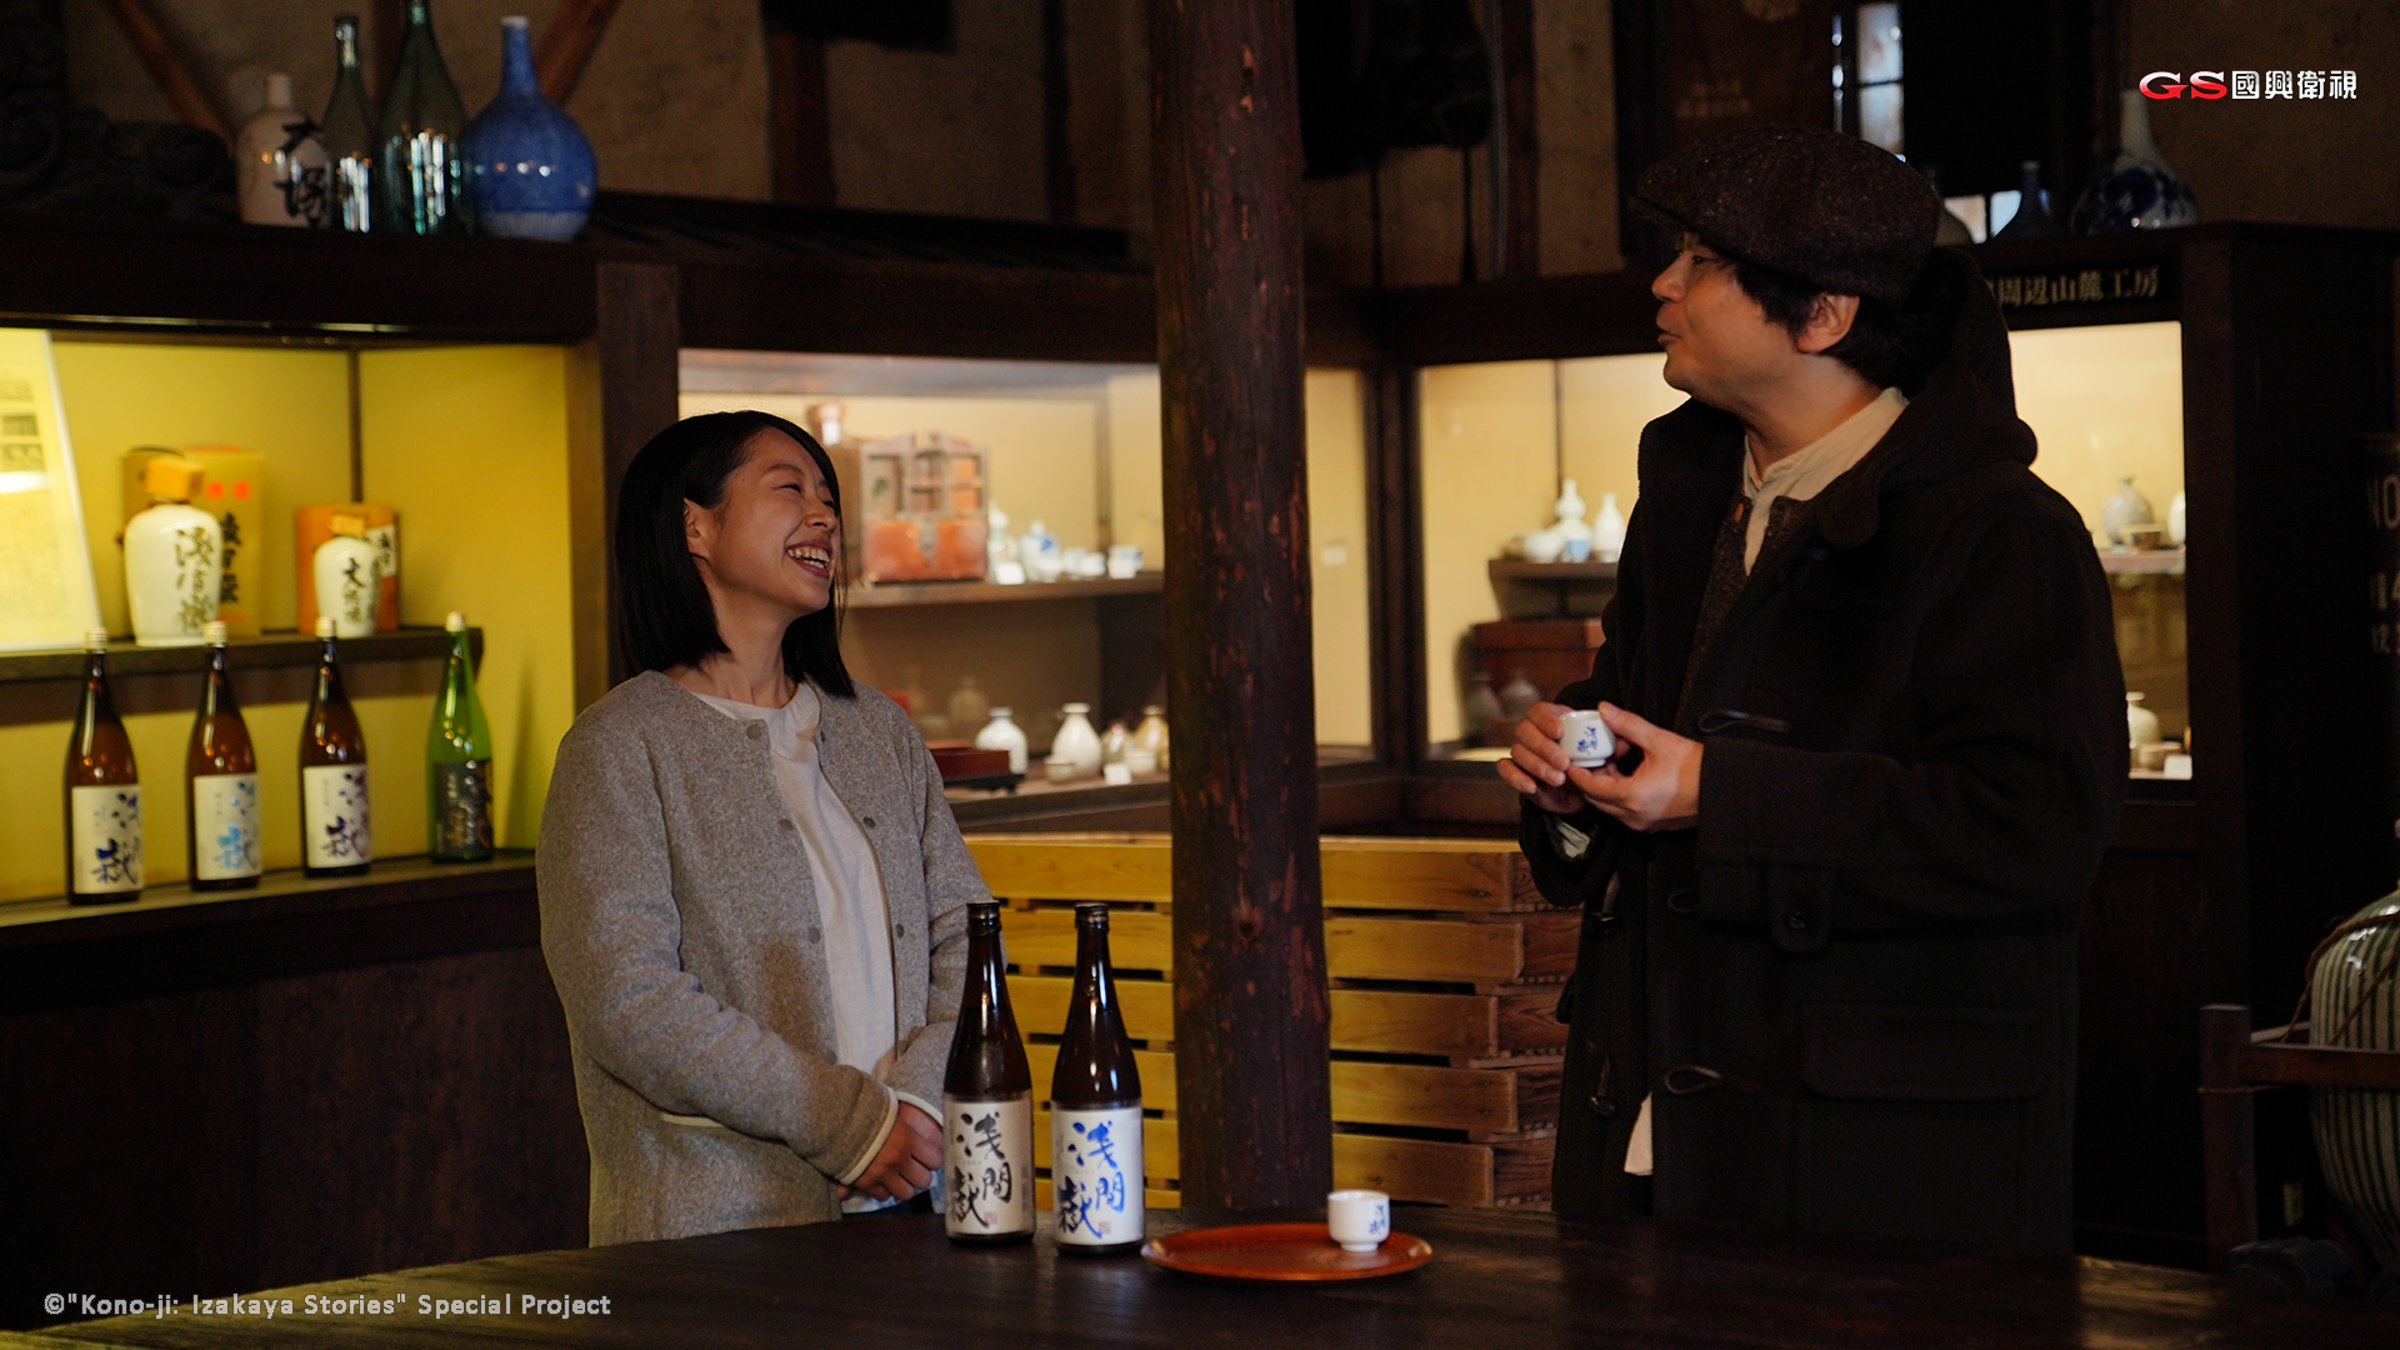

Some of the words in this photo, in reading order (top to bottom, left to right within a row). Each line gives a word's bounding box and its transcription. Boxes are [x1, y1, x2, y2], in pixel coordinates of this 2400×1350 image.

[1986, 266, 2158, 307] 周辺山麓工房
